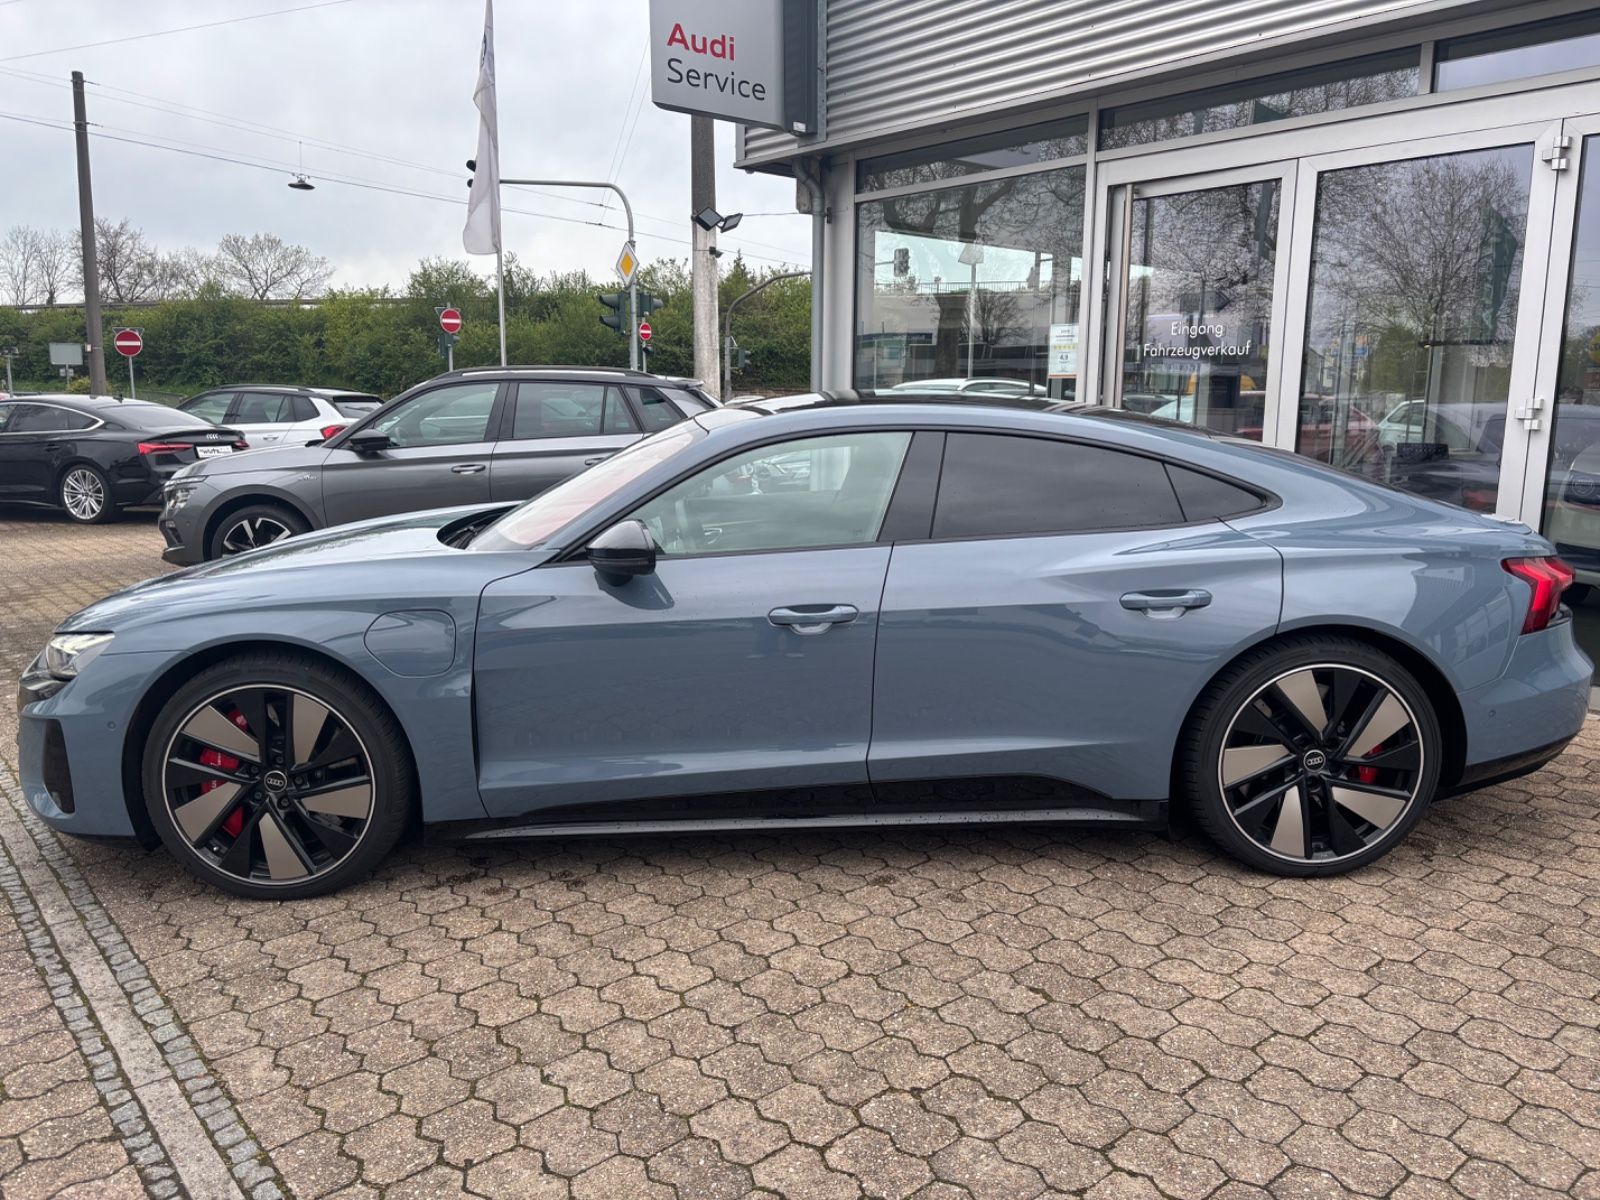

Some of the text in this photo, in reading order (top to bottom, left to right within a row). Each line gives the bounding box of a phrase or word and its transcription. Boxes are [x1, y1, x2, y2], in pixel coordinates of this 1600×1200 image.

[667, 23, 735, 61] Audi
[667, 58, 766, 101] Service
[1171, 321, 1224, 338] Eingang
[1143, 340, 1252, 360] Fahrzeugverkauf
